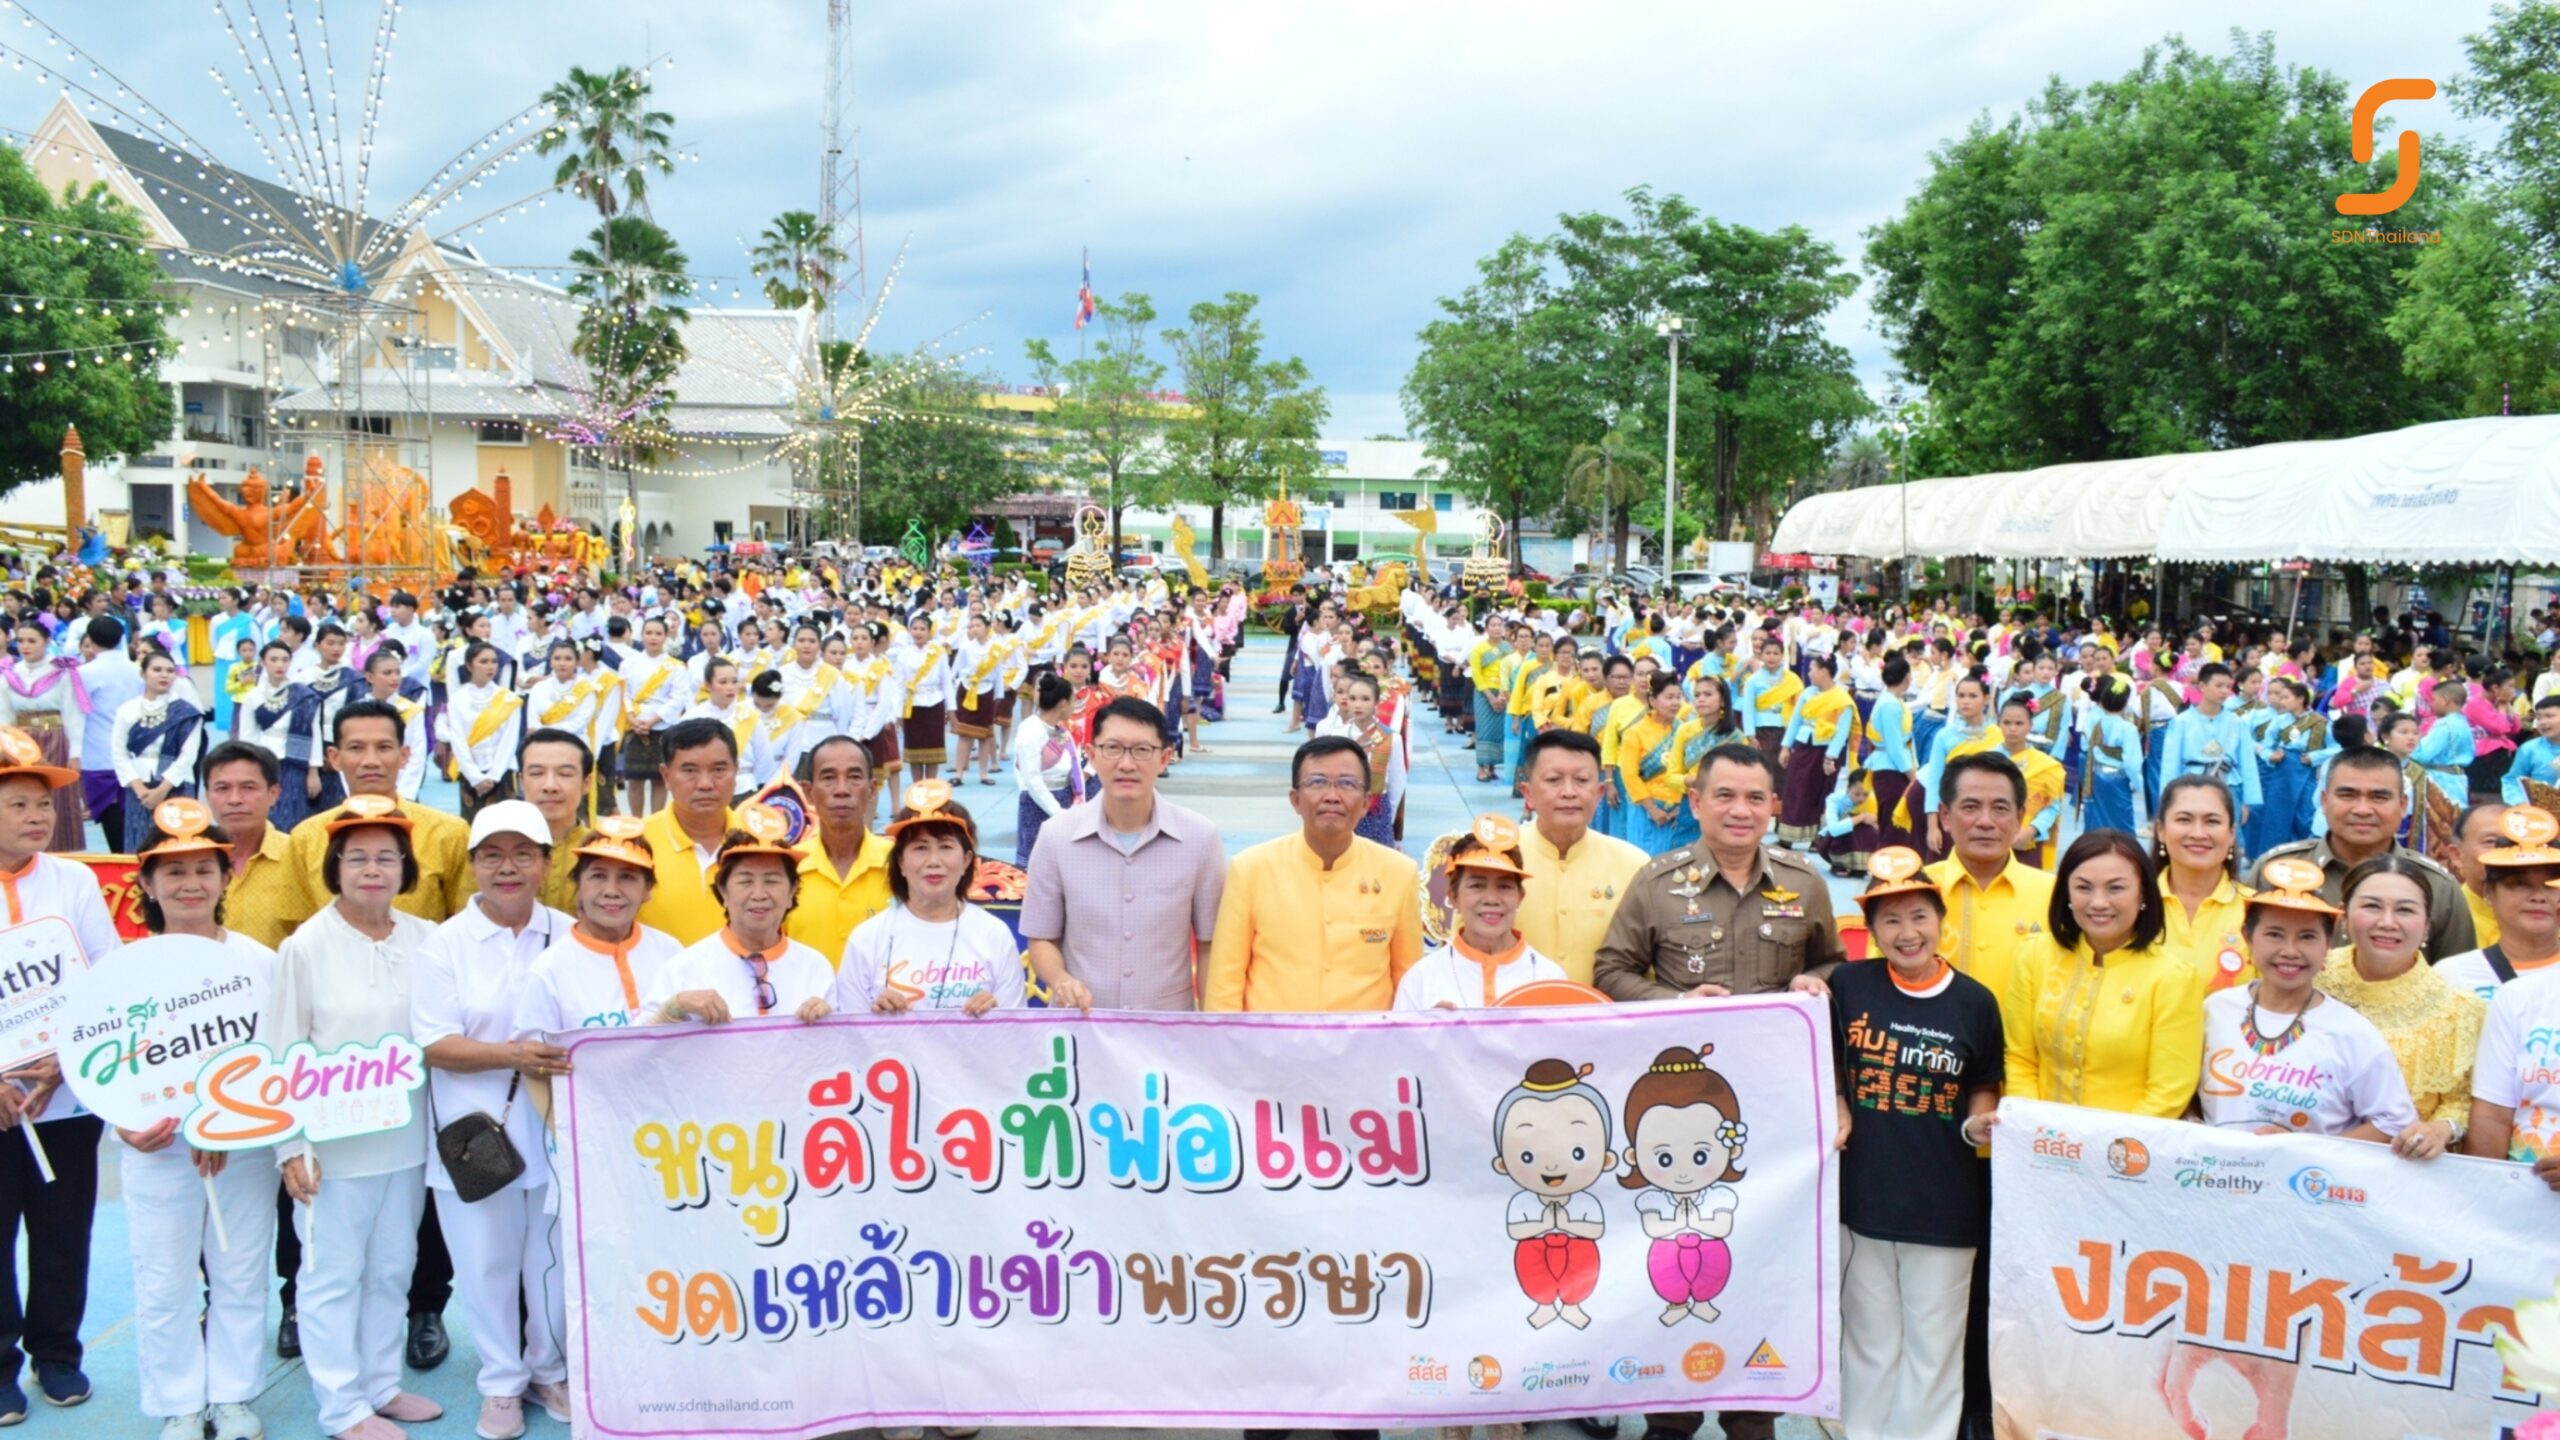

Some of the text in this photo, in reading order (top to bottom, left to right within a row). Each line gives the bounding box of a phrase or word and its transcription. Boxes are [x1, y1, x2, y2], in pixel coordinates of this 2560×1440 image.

[886, 959, 987, 1004] Sobrink
[72, 1017, 122, 1043] สังคม
[164, 974, 252, 1013] ปลอดเหล้า
[80, 1012, 259, 1086] Healthy
[1847, 1011, 1964, 1077] ดื่ม เท่ากับ
[196, 1045, 415, 1141] Sobrink
[2203, 1047, 2325, 1098] Sobrink
[2174, 1168, 2264, 1194] Healthy
[2326, 1184, 2367, 1204] 1413
[635, 1218, 1426, 1338] งดเหล้าเข้าพรรษา
[637, 1397, 794, 1415] www.sdnthailand.com
[1522, 1374, 1591, 1392] Healthy
